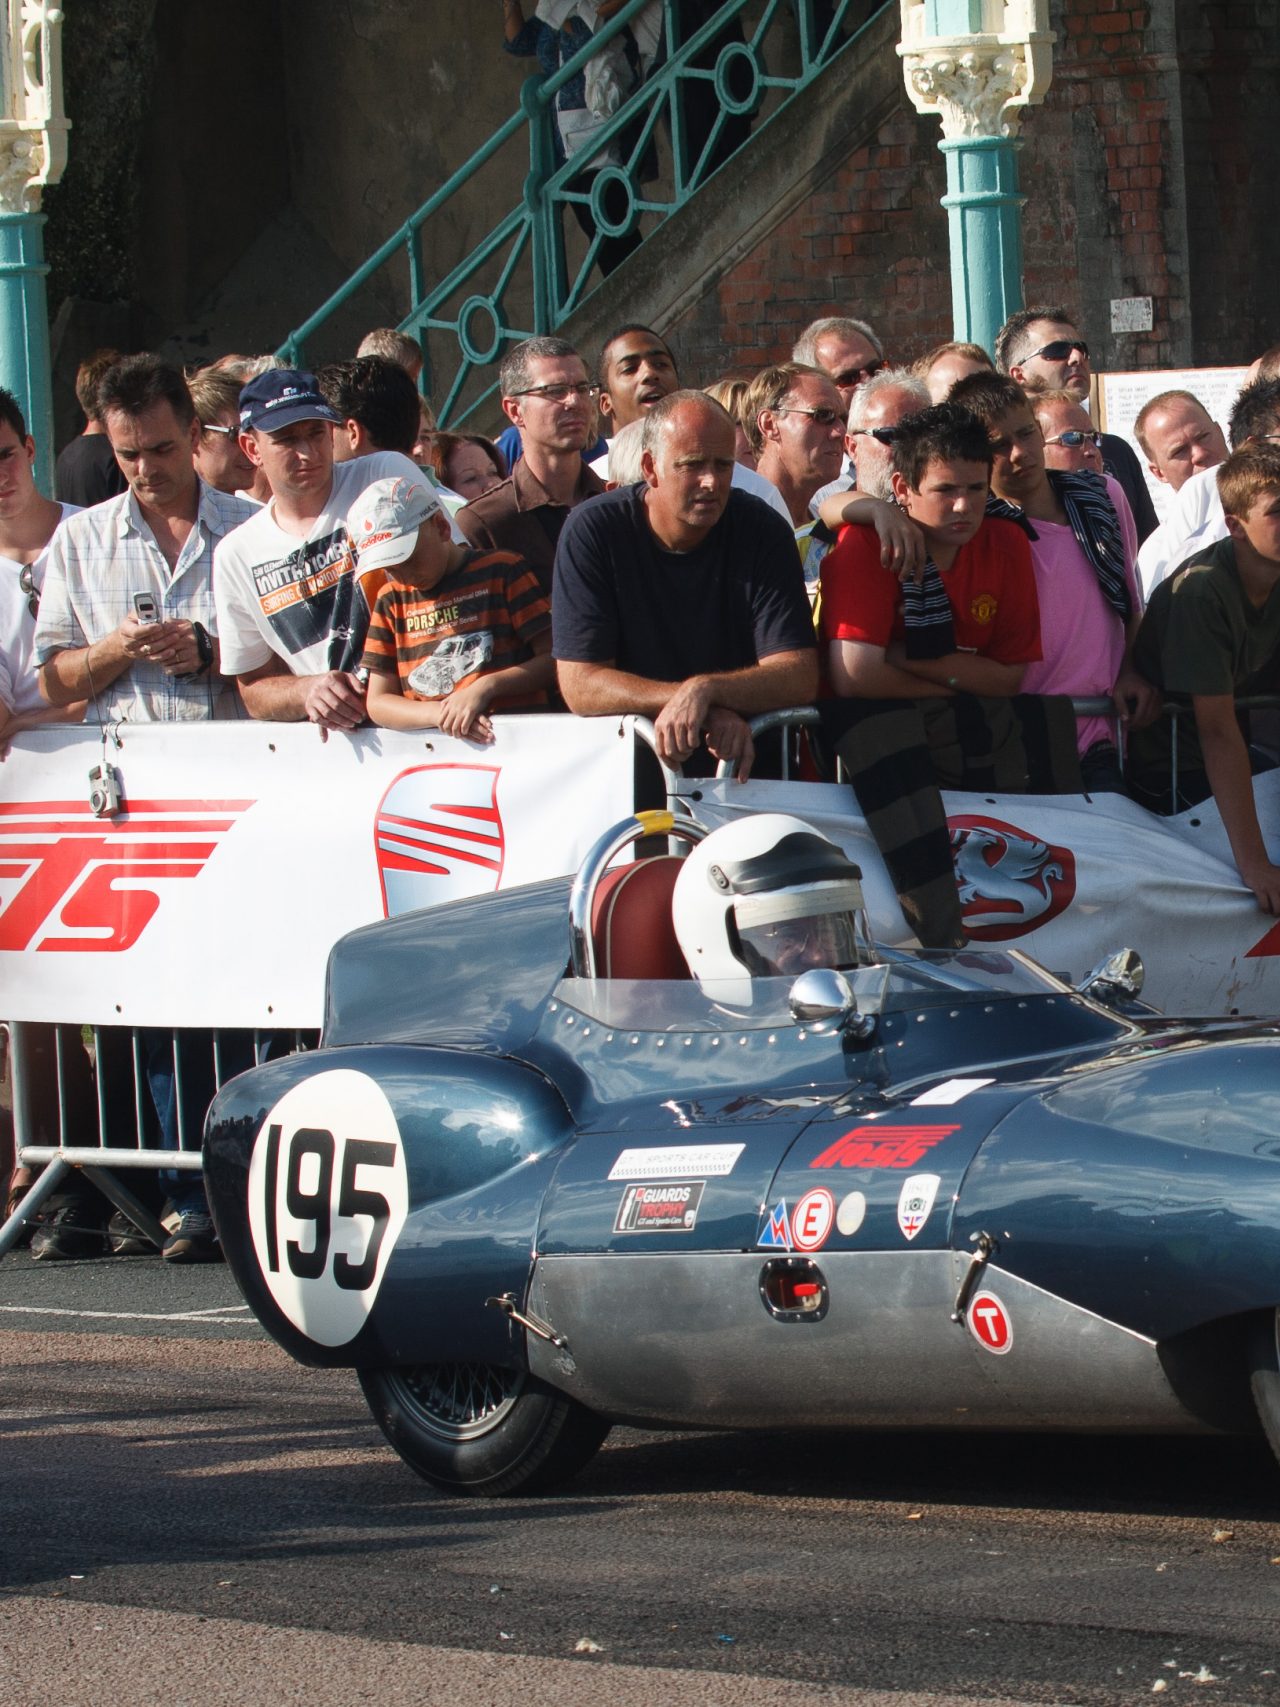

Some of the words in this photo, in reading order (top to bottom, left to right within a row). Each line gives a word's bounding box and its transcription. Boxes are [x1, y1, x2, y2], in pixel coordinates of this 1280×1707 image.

[361, 531, 392, 549] vodafone
[406, 606, 459, 632] PORSCHE
[265, 1124, 397, 1291] 195
[643, 1187, 691, 1203] GUARDS
[640, 1202, 687, 1217] TROPHY
[803, 1203, 822, 1236] E
[976, 1307, 998, 1342] T
